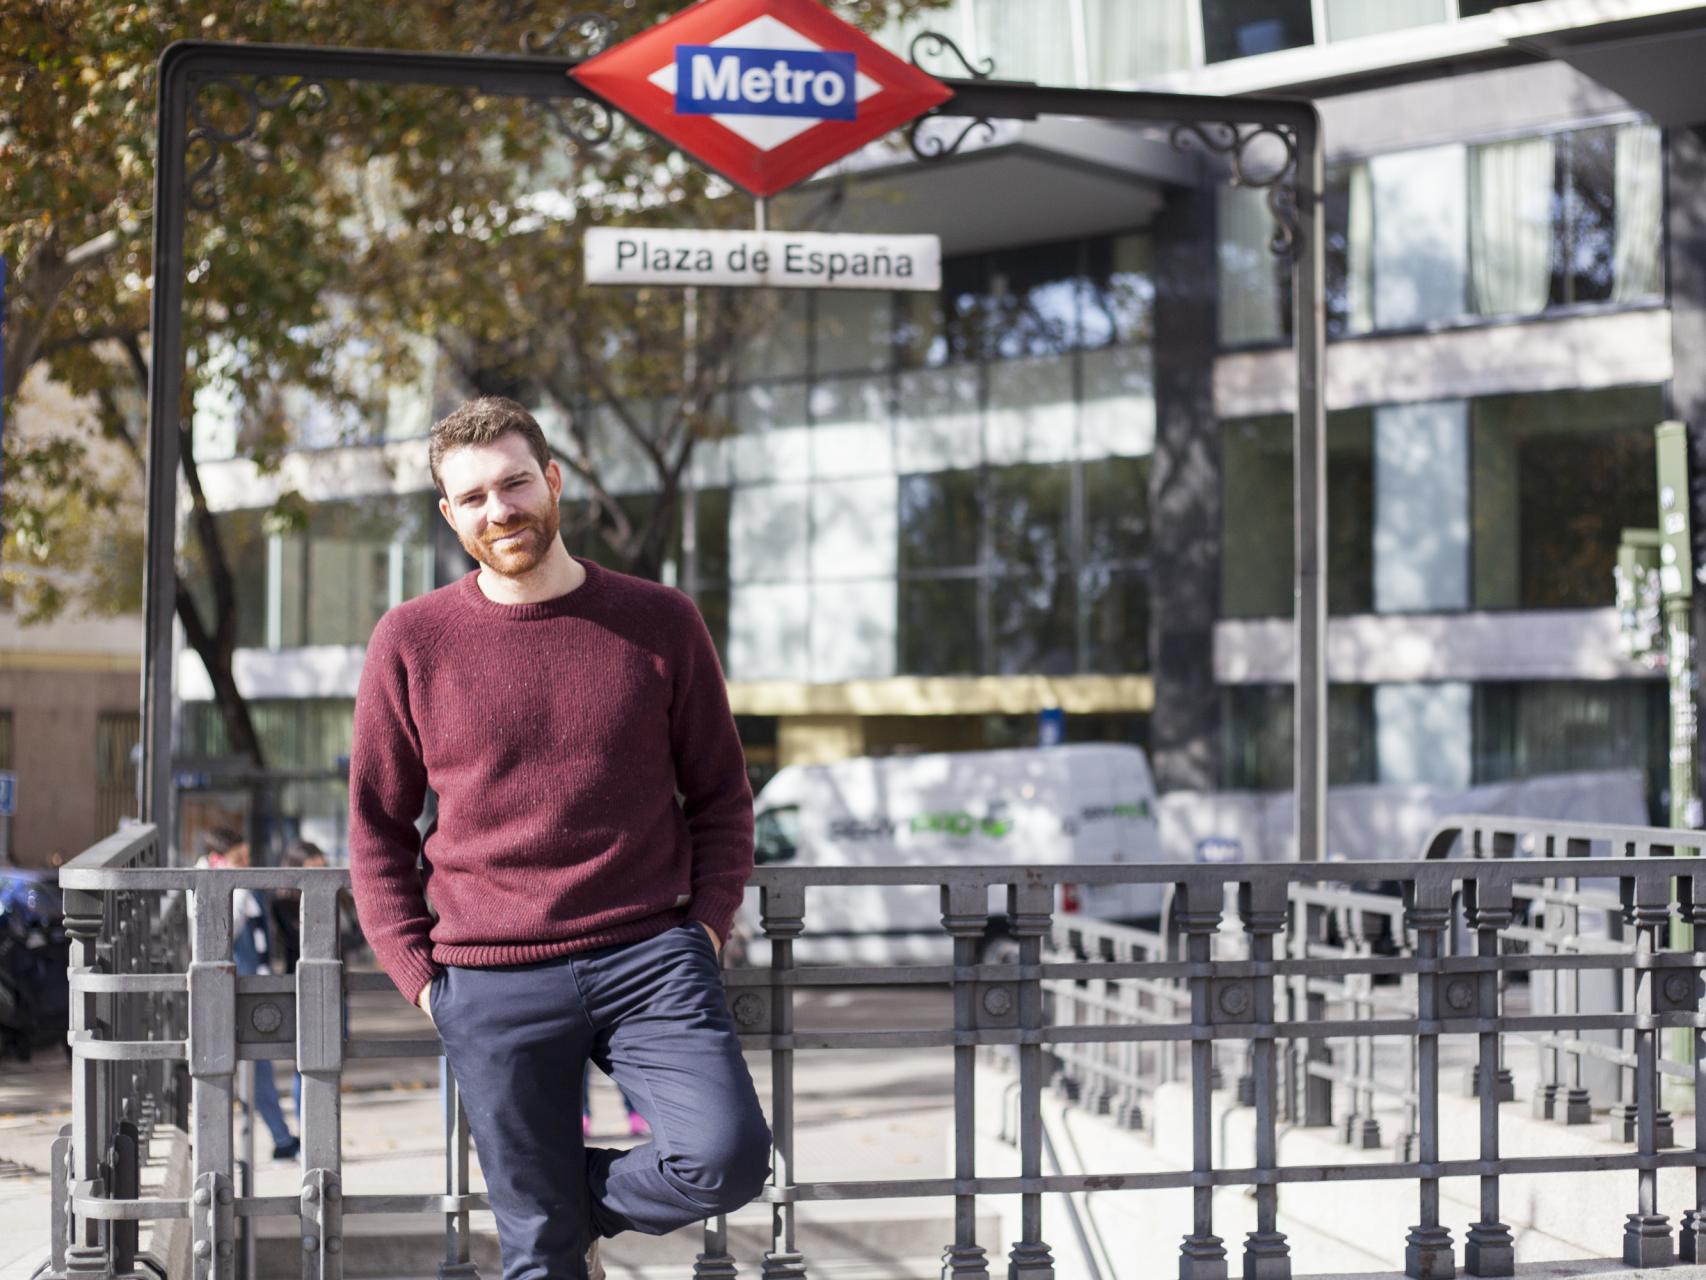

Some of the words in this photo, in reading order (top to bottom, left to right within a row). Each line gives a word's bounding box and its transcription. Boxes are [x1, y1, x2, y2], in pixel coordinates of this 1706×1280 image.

[691, 55, 846, 106] Metro
[616, 240, 713, 272] Plaza
[727, 243, 769, 273] de
[784, 245, 913, 281] España
